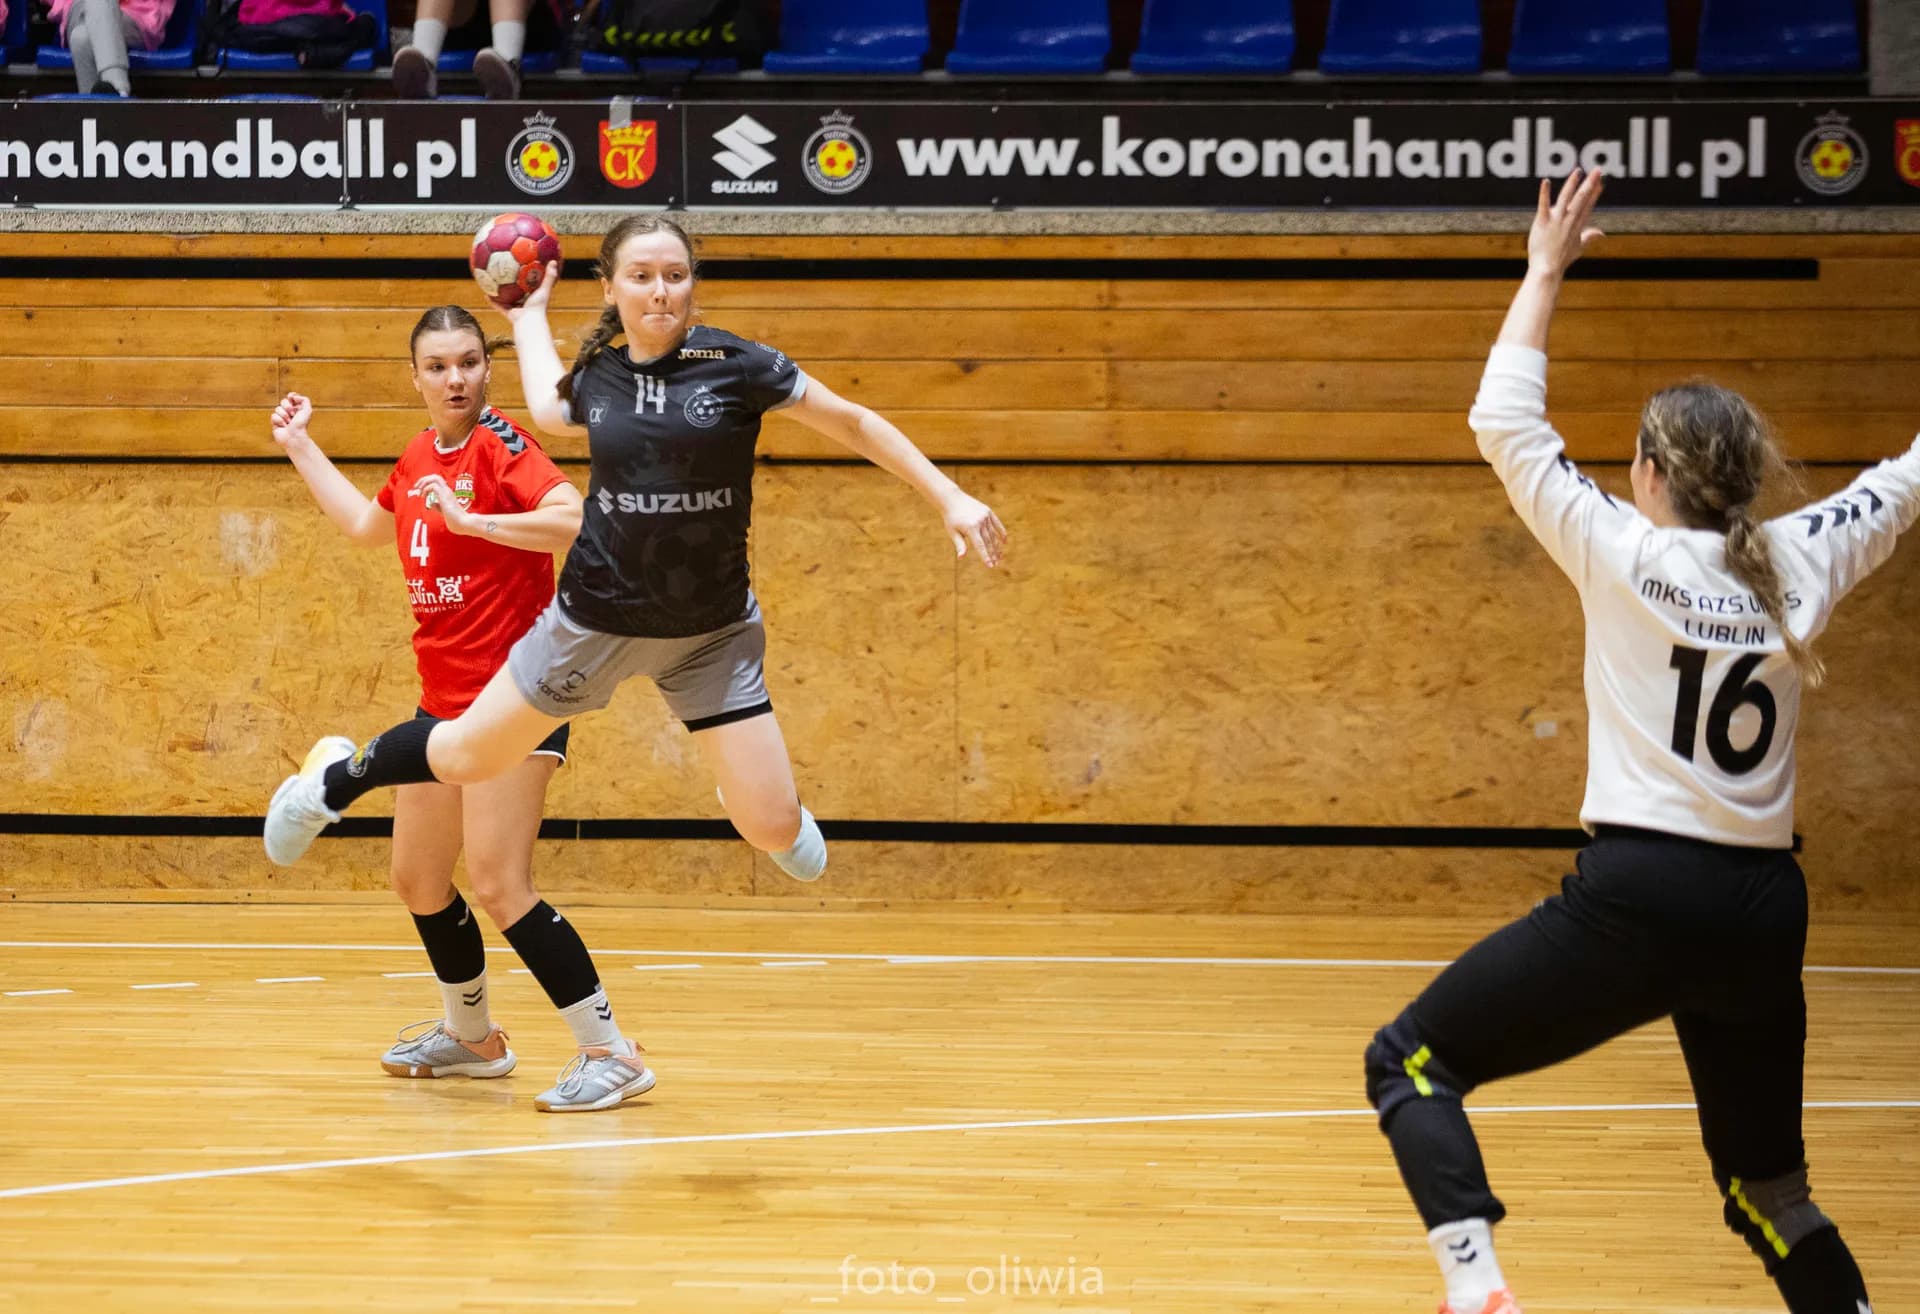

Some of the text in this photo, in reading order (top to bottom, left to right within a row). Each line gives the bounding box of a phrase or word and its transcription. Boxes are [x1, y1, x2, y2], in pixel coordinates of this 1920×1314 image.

[604, 147, 647, 182] CK
[897, 116, 1767, 198] www.koronahandball.pl
[711, 180, 778, 194] SUZUKI
[634, 373, 667, 415] 14
[617, 487, 733, 514] SUZUKI
[410, 518, 431, 567] 4
[1641, 578, 1692, 609] MKS
[1699, 594, 1745, 616] AZS
[1684, 619, 1766, 645] LUBLIN
[1669, 644, 1777, 777] 16
